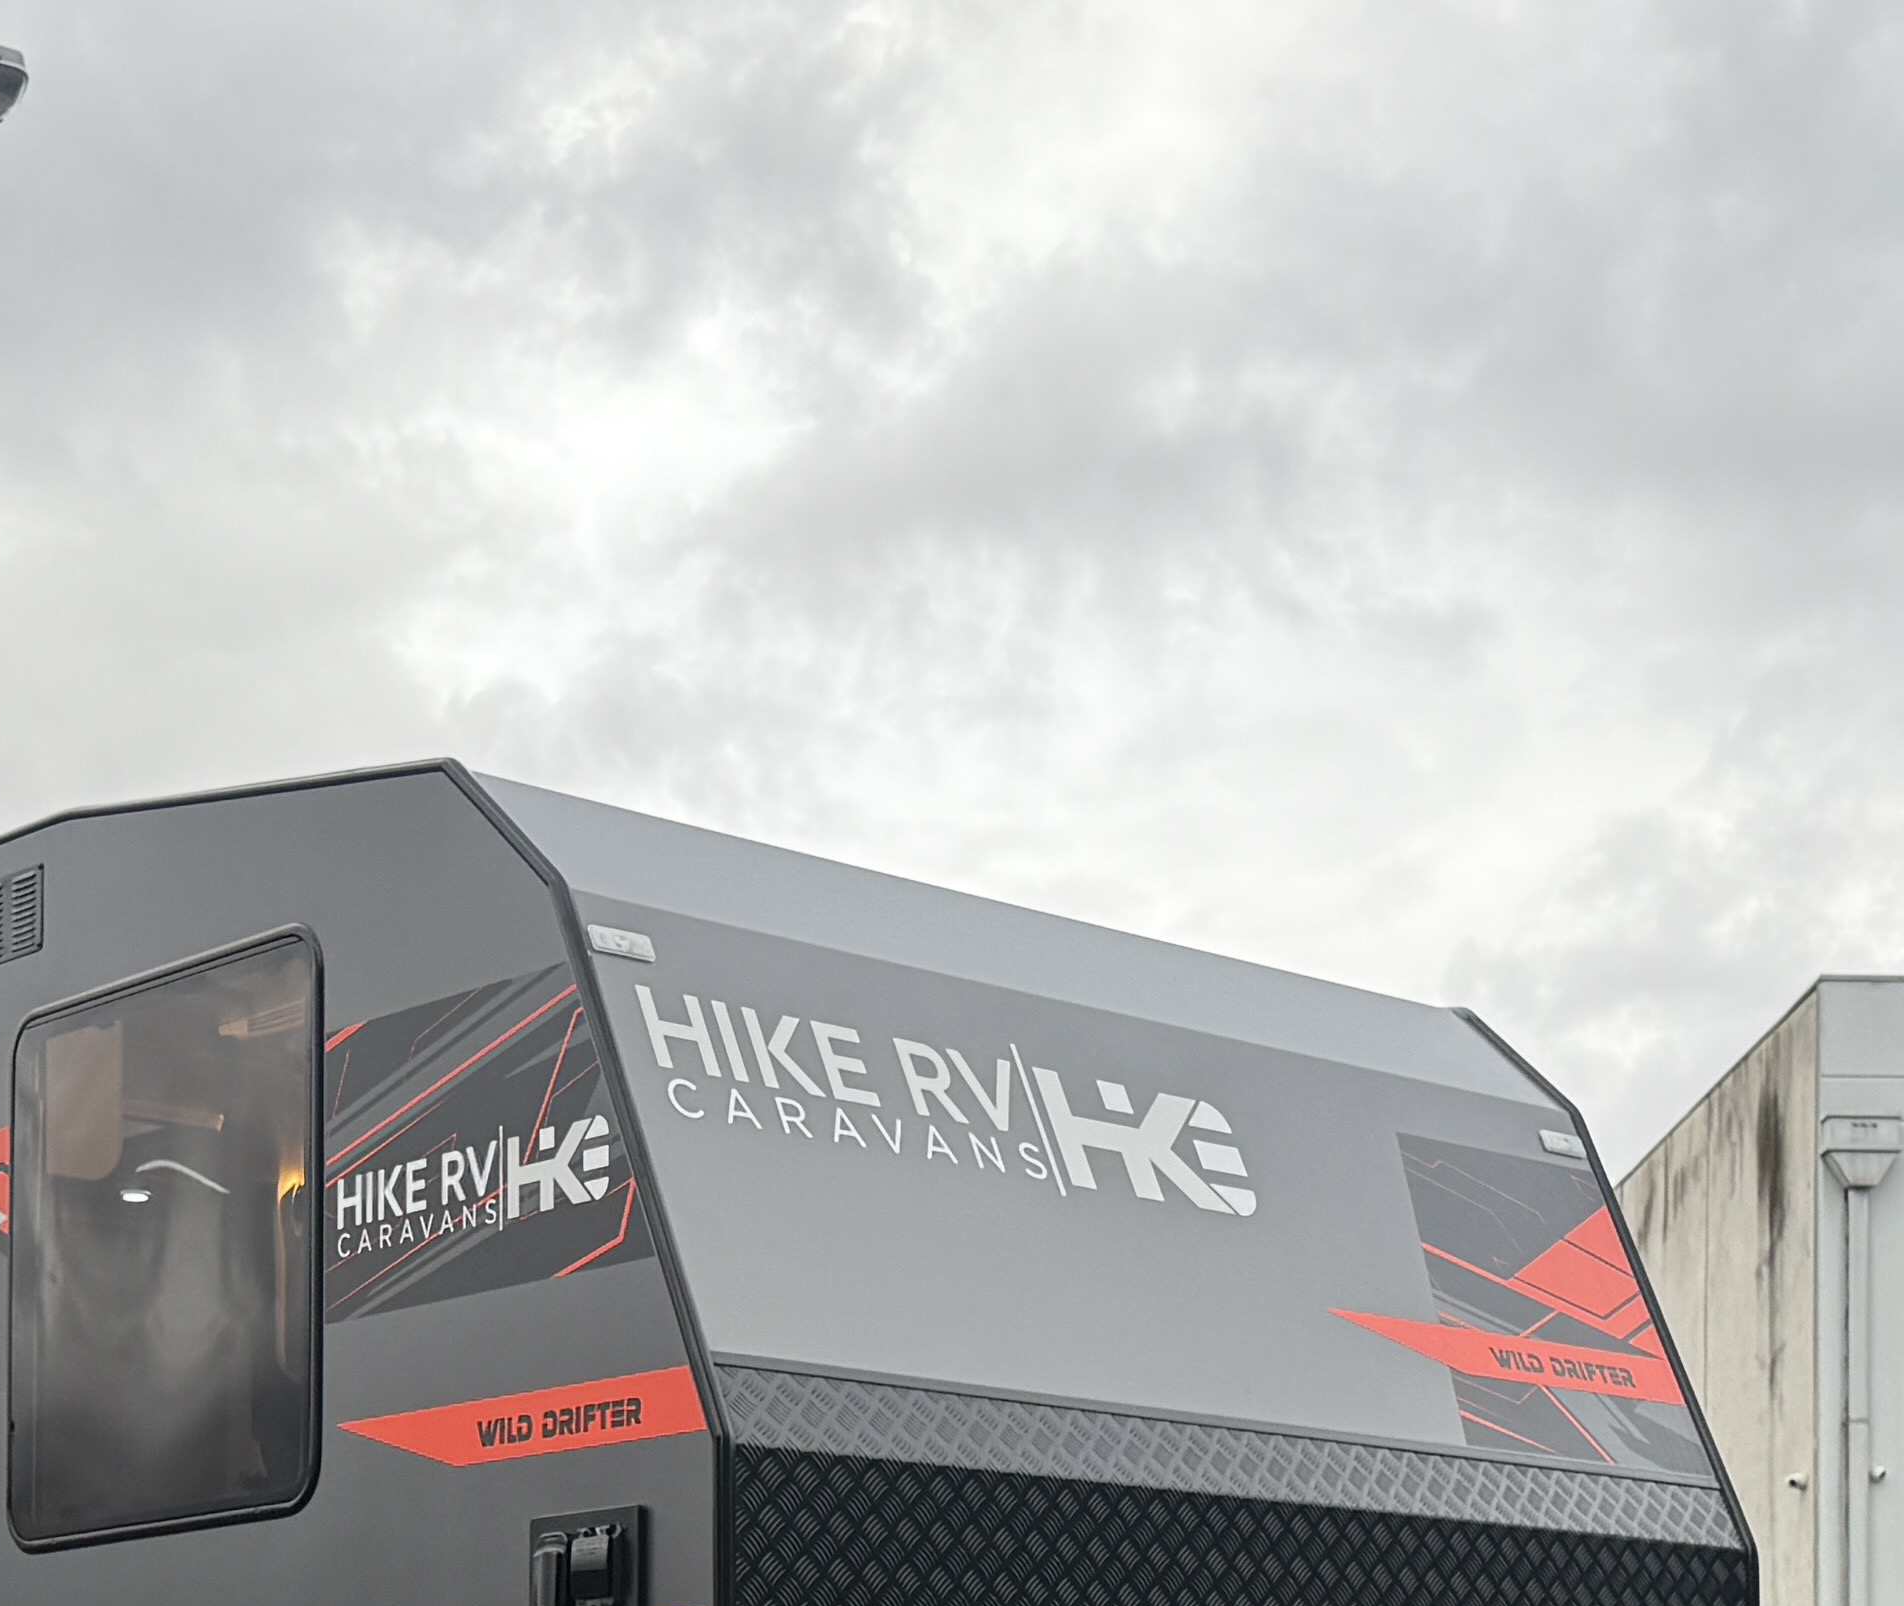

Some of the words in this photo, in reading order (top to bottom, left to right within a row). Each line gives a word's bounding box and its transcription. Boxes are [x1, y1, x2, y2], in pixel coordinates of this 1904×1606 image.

[635, 984, 881, 1107] HIKE
[893, 1037, 1011, 1132] RV
[666, 1077, 1049, 1180] CARAVANS
[336, 1157, 428, 1230] HIKE
[441, 1139, 498, 1206] RV
[337, 1198, 498, 1258] CARAVANS
[1489, 1346, 1545, 1375] WILD
[1549, 1356, 1636, 1389] DRIFTER
[476, 1414, 533, 1448] WILD
[542, 1397, 643, 1439] DRIFTER
